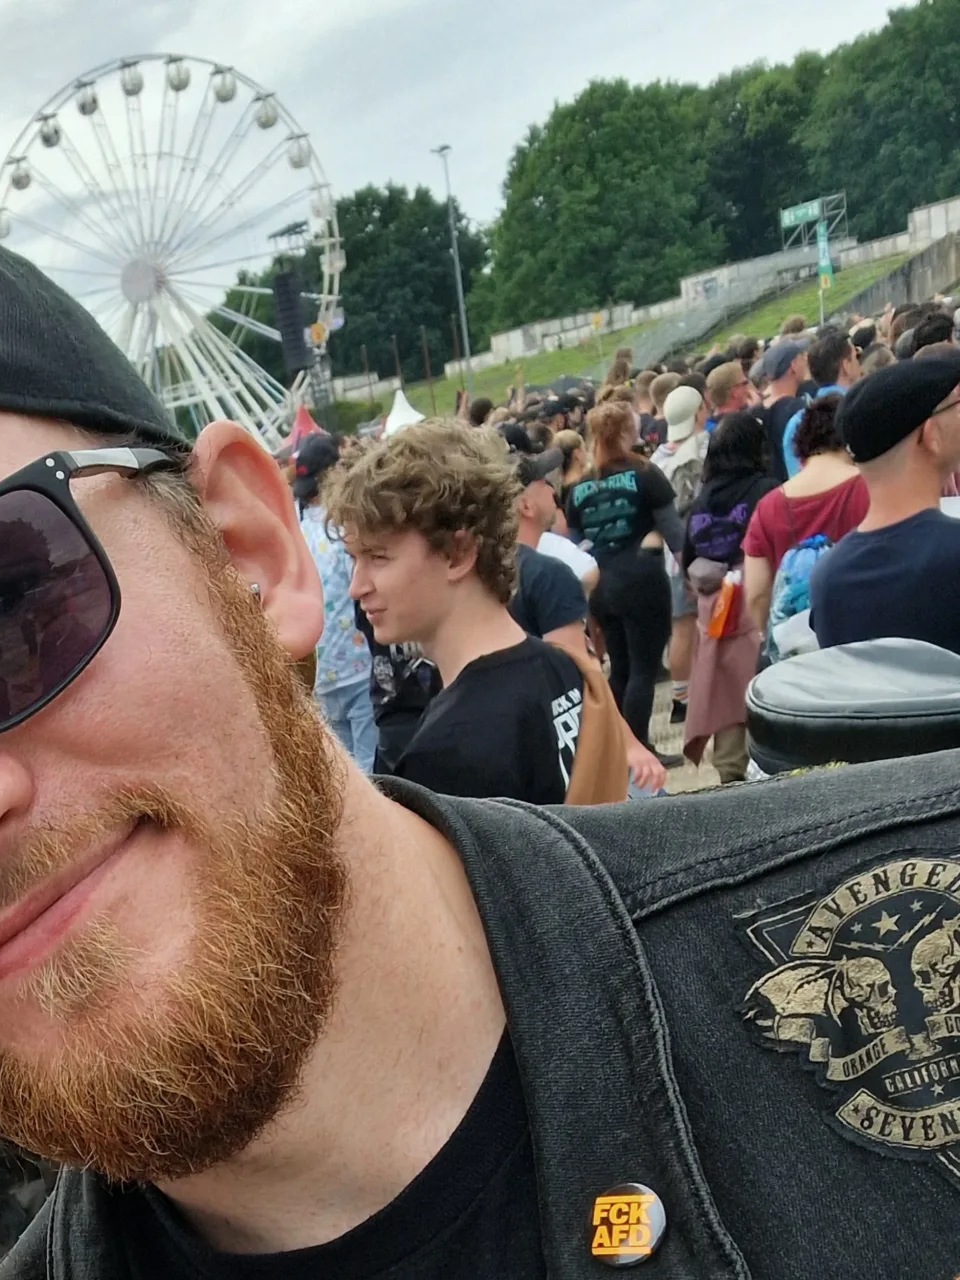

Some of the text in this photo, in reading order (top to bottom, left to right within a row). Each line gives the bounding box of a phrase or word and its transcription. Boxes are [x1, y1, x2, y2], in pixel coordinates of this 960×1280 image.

[843, 1037, 889, 1079] ORANGE
[860, 1106, 960, 1142] SEVEN
[592, 1202, 651, 1225] FCK
[591, 1225, 651, 1247] AFD
